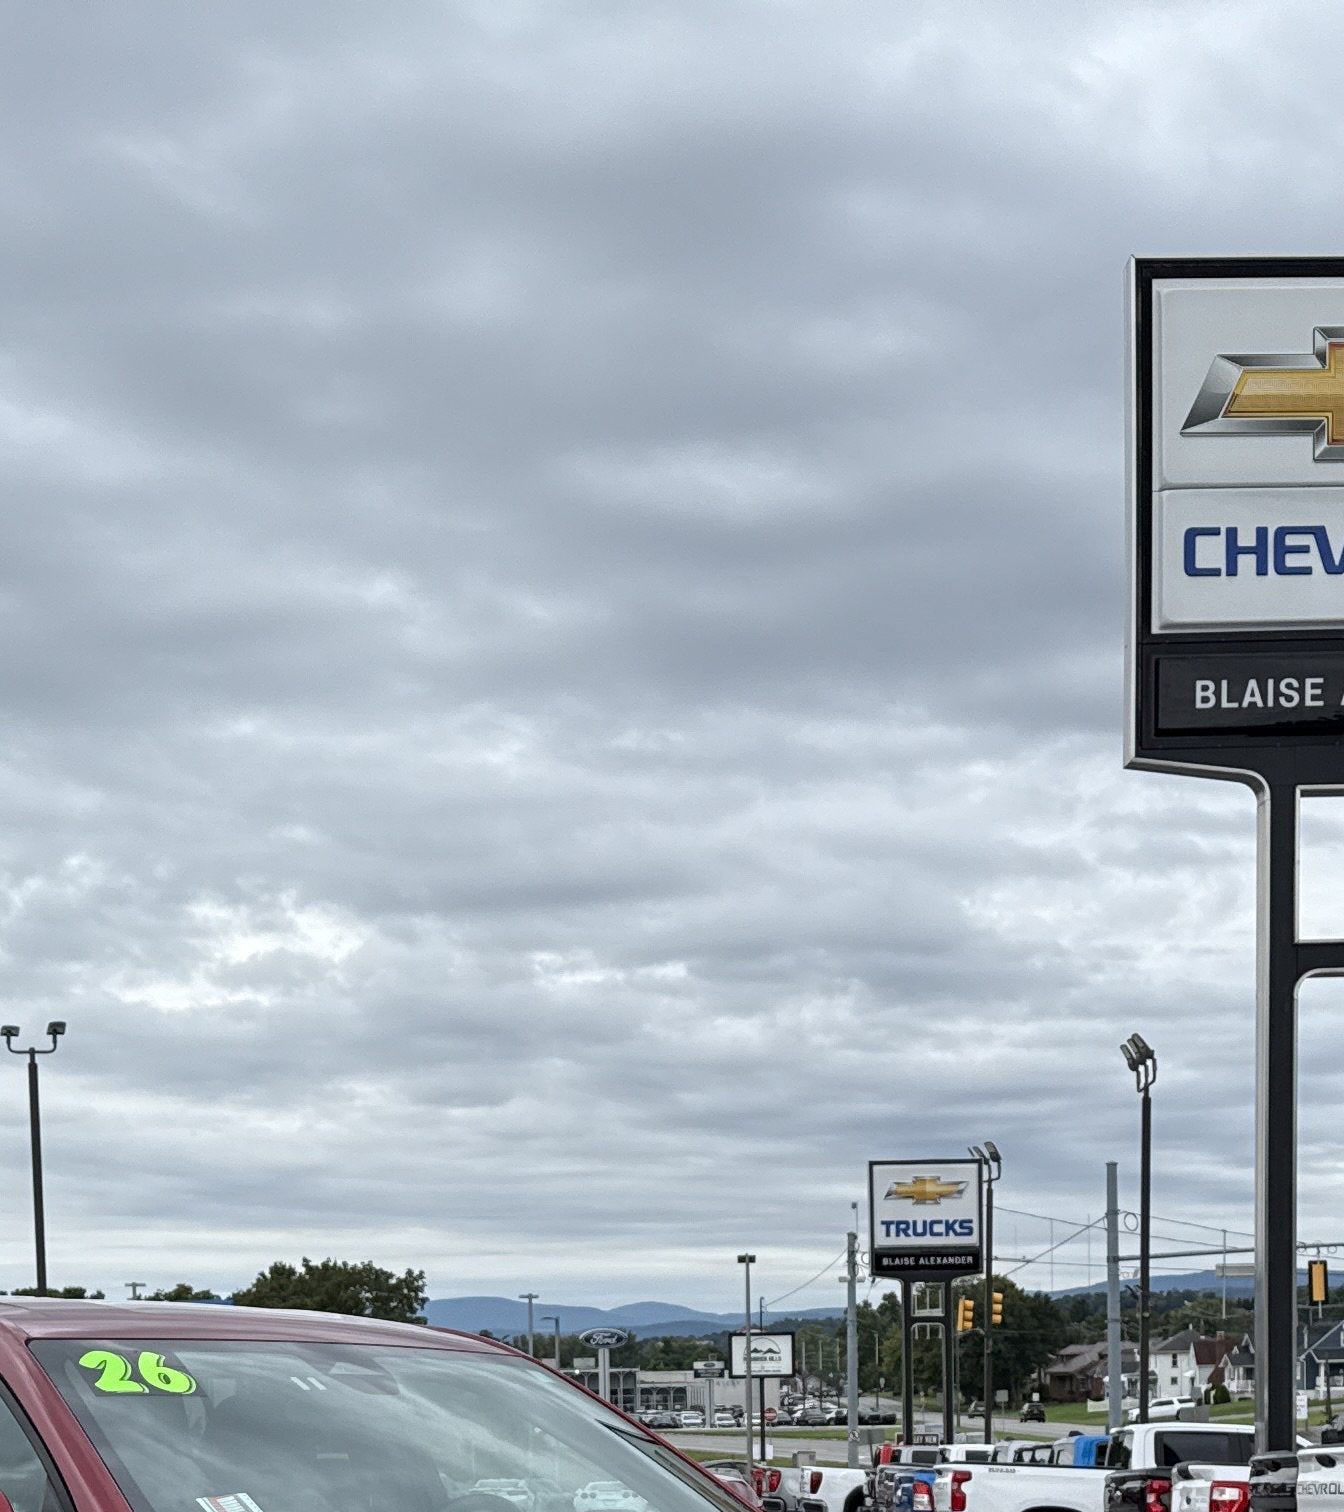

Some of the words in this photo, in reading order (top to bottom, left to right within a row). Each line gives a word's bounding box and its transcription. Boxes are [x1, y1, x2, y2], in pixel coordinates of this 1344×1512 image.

[1194, 677, 1325, 709] BLAISE
[880, 1219, 974, 1237] TRUCKS
[882, 1256, 915, 1266] BLAISE
[918, 1256, 973, 1265] ALEXANDER
[590, 1331, 619, 1345] Ford
[79, 1351, 197, 1395] 26
